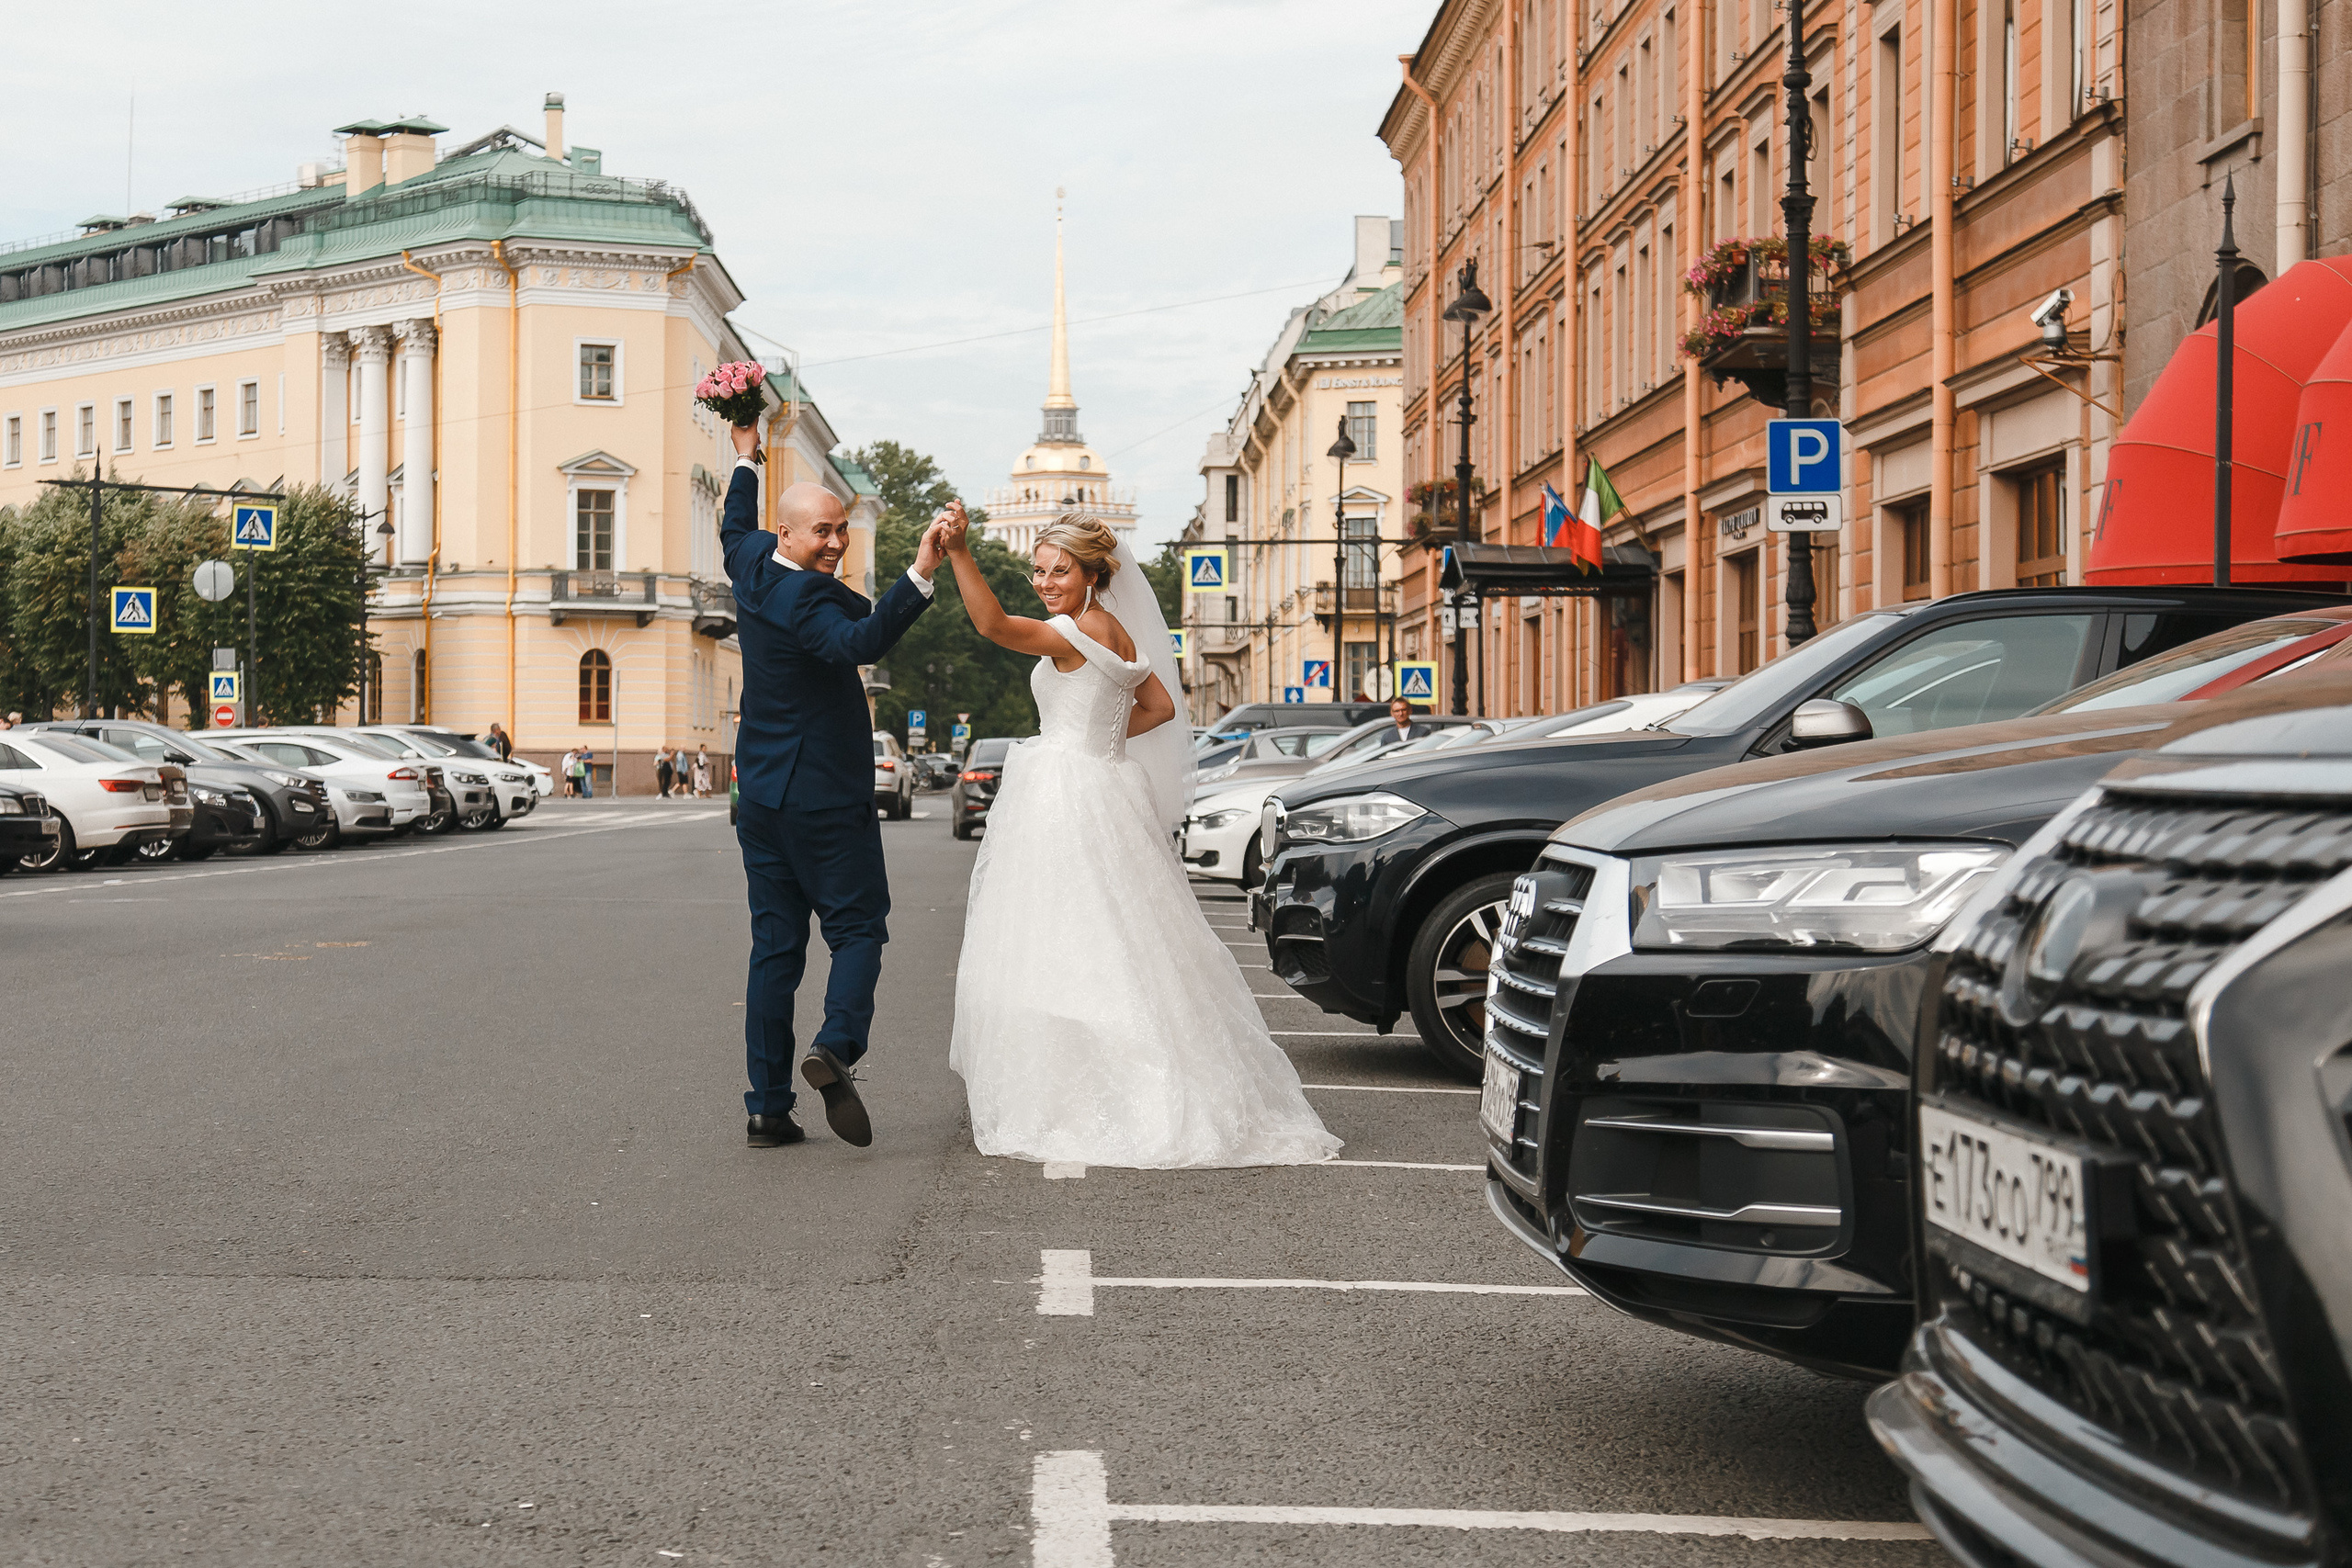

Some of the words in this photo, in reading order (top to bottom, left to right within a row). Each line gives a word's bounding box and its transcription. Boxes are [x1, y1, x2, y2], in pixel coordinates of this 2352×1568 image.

[1790, 428, 1829, 486] P
[912, 711, 923, 727] P
[2030, 1153, 2075, 1237] 799
